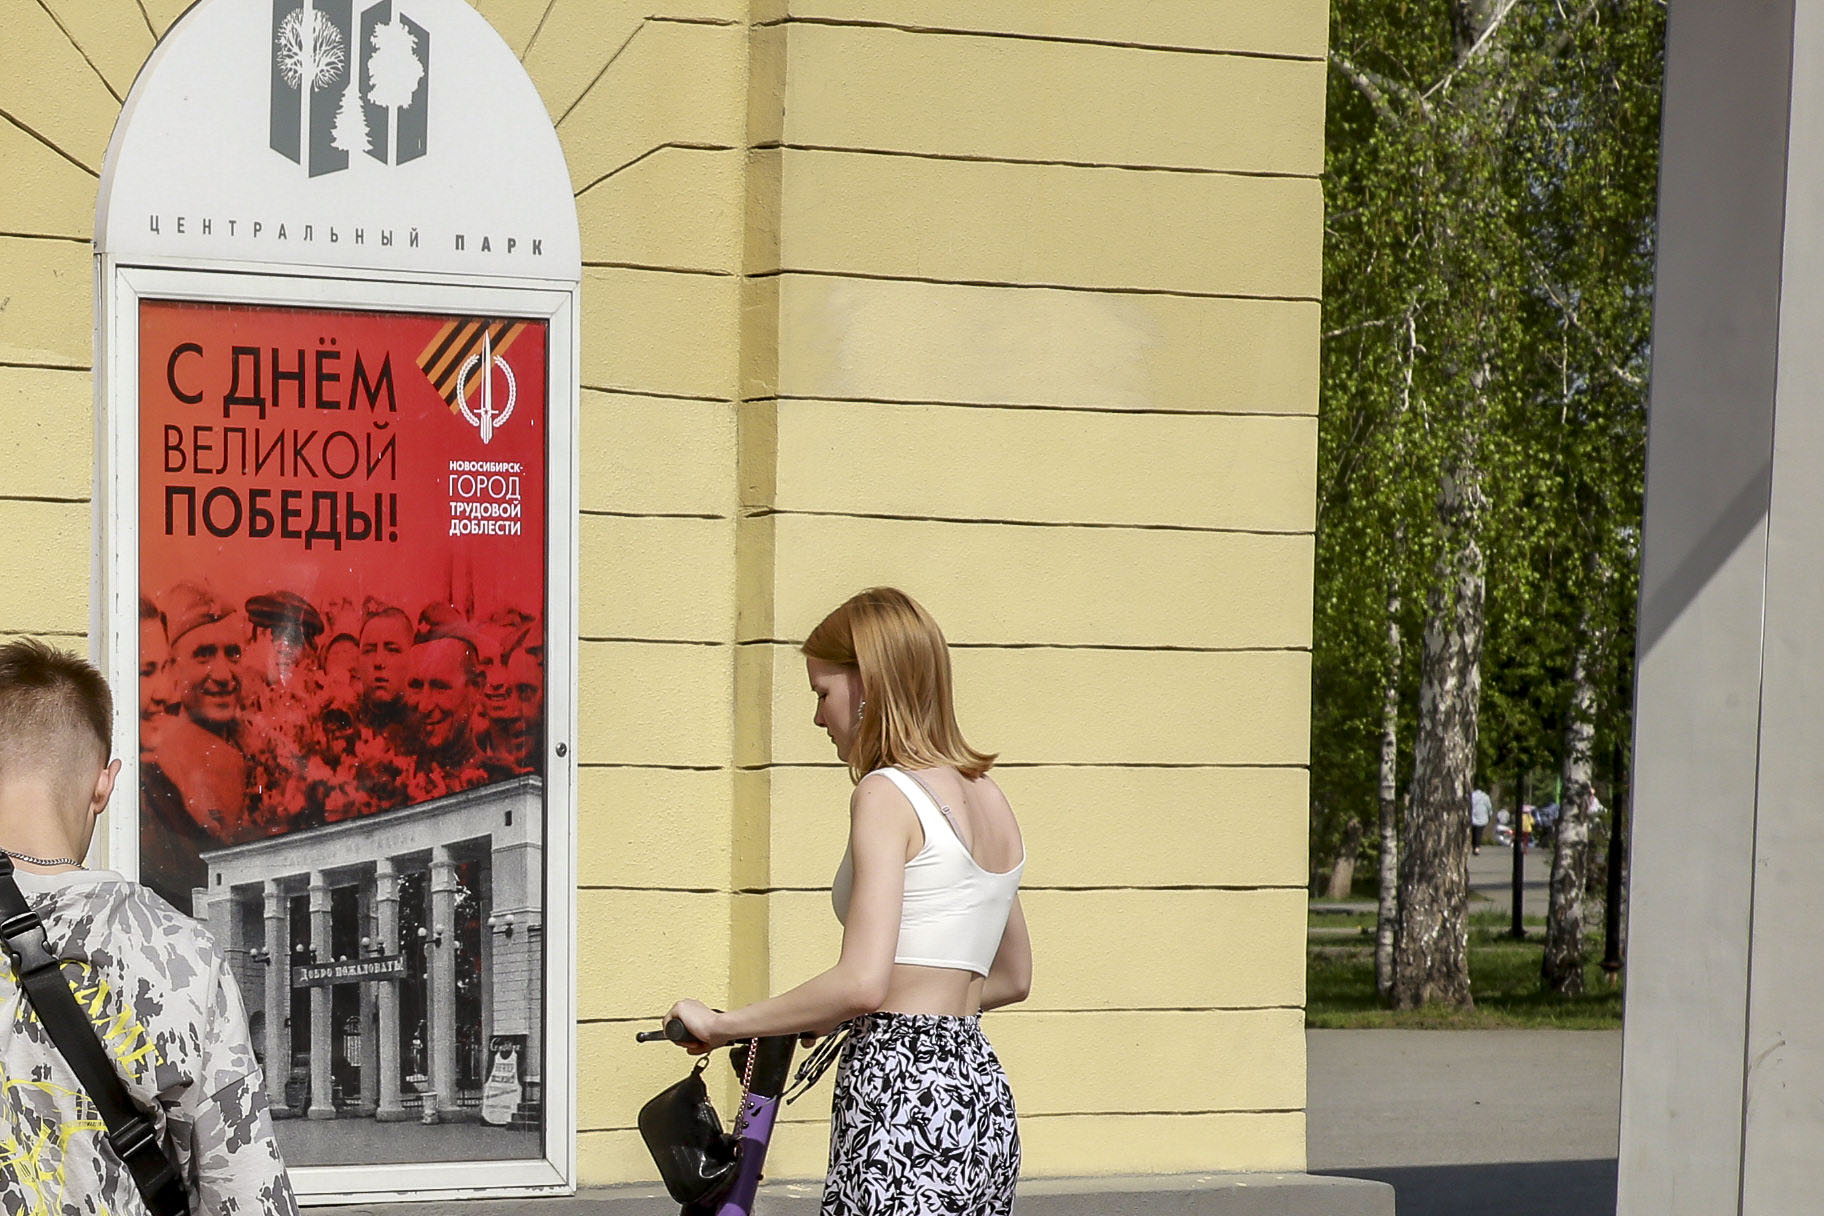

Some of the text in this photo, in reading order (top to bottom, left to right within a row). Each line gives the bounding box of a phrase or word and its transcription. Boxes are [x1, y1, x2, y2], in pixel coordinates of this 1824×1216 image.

[149, 214, 544, 257] ЦЕНТРАЛЬНЫЙ ПАРК
[166, 336, 397, 420] С ДНЁМ
[164, 420, 397, 482] ВЕЛИКОЙ
[449, 460, 524, 473] НОВОСИБИРСК-
[449, 474, 522, 501] ГОРОД
[164, 485, 399, 552] ПОБЕДЫ!
[449, 500, 522, 520] ТРУДОВОЙ
[449, 519, 522, 537] ДОБЛЕСТИ
